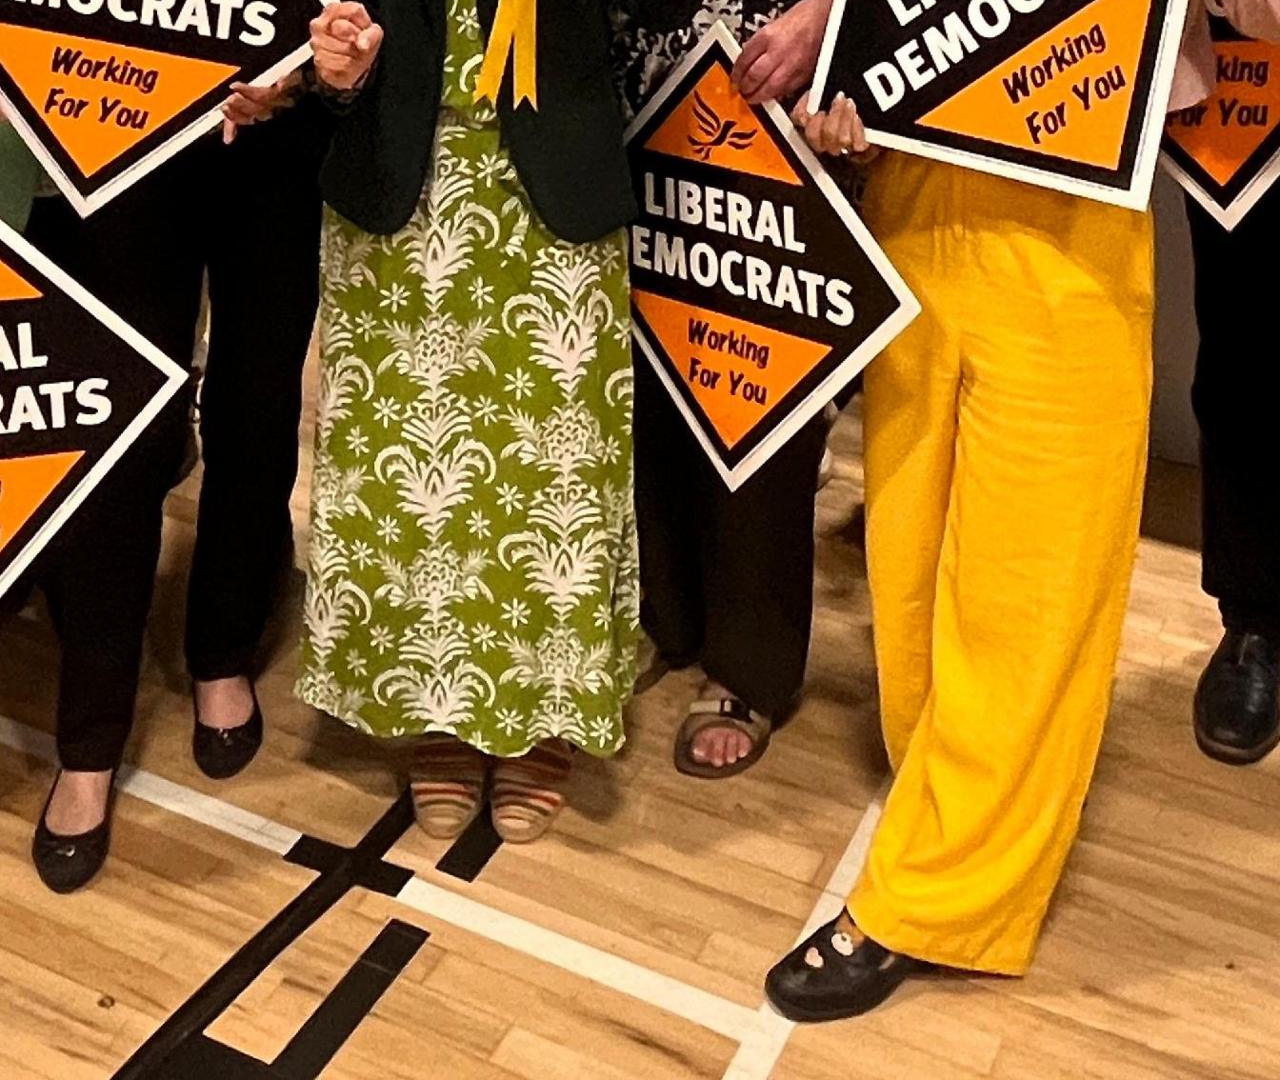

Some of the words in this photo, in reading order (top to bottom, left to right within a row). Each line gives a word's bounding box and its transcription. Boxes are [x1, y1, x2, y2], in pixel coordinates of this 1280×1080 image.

[51, 47, 159, 95] Working
[1002, 23, 1106, 105] Working
[44, 88, 89, 120] For
[98, 95, 150, 130] You
[1025, 100, 1068, 145] For
[1072, 64, 1126, 113] You
[1219, 98, 1269, 127] You
[644, 172, 806, 253] LIBERAL
[632, 224, 855, 327] EMOCRATS
[686, 318, 770, 369] Working
[688, 357, 723, 390] For
[728, 374, 767, 406] You
